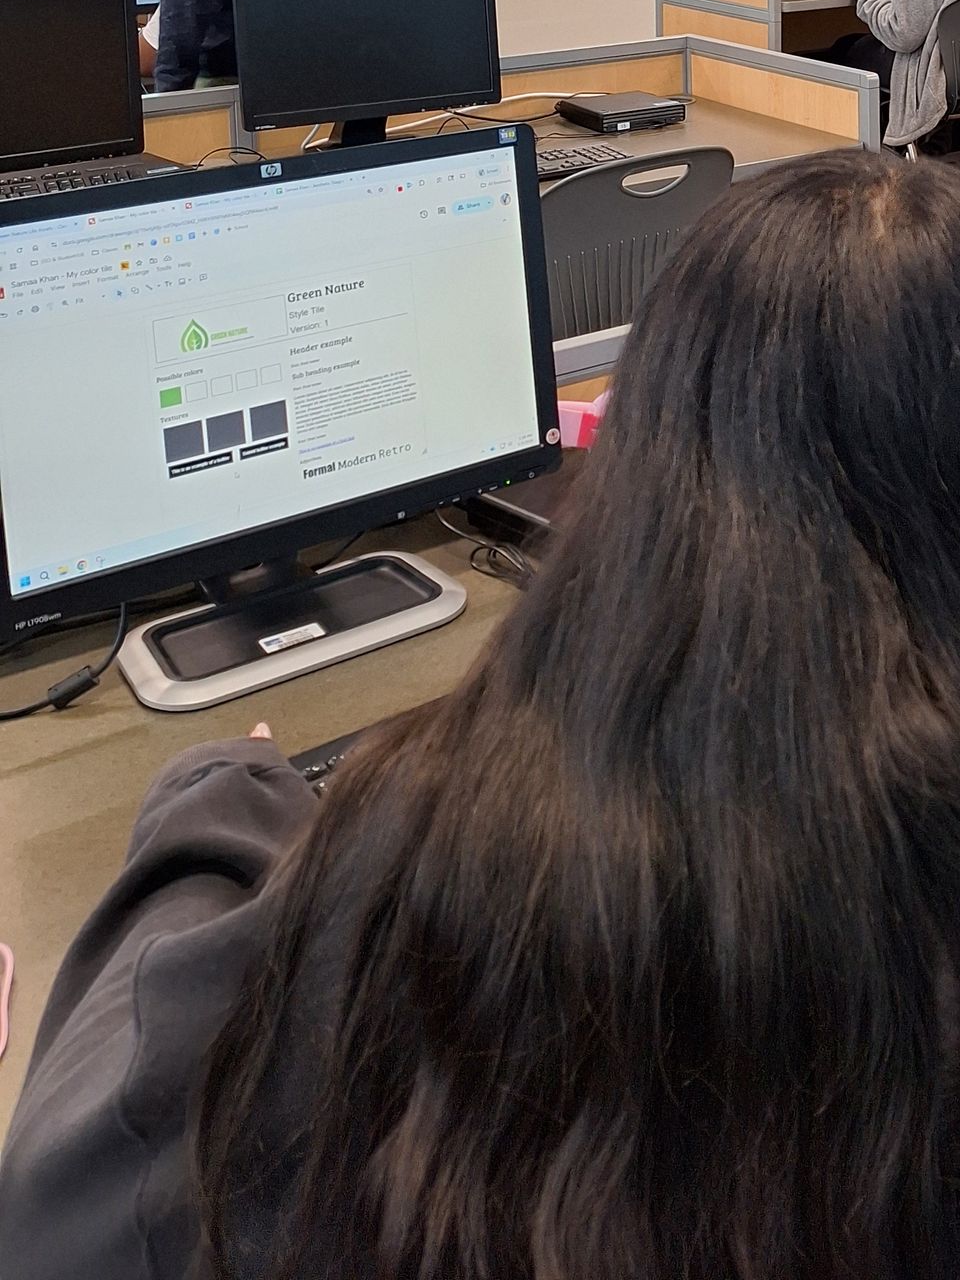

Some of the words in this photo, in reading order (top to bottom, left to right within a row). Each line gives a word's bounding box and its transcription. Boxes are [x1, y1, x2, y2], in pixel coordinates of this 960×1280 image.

[11, 278, 38, 288] Samaa
[39, 273, 59, 283] Khan
[66, 271, 78, 281] My
[80, 267, 100, 277] color
[287, 289, 322, 303] Green
[325, 280, 365, 296] Nature
[289, 310, 309, 320] Style
[311, 306, 325, 314] Tile
[290, 345, 319, 356] Header
[320, 335, 353, 349] example
[156, 372, 183, 384] Possible
[184, 368, 204, 379] colors
[292, 372, 304, 380] Sub
[305, 365, 333, 377] heading
[333, 359, 360, 371] example
[160, 412, 189, 423] Textures
[303, 461, 336, 479] Formal
[337, 453, 377, 471] Modern
[378, 443, 412, 459] Retro
[15, 621, 26, 631] HP
